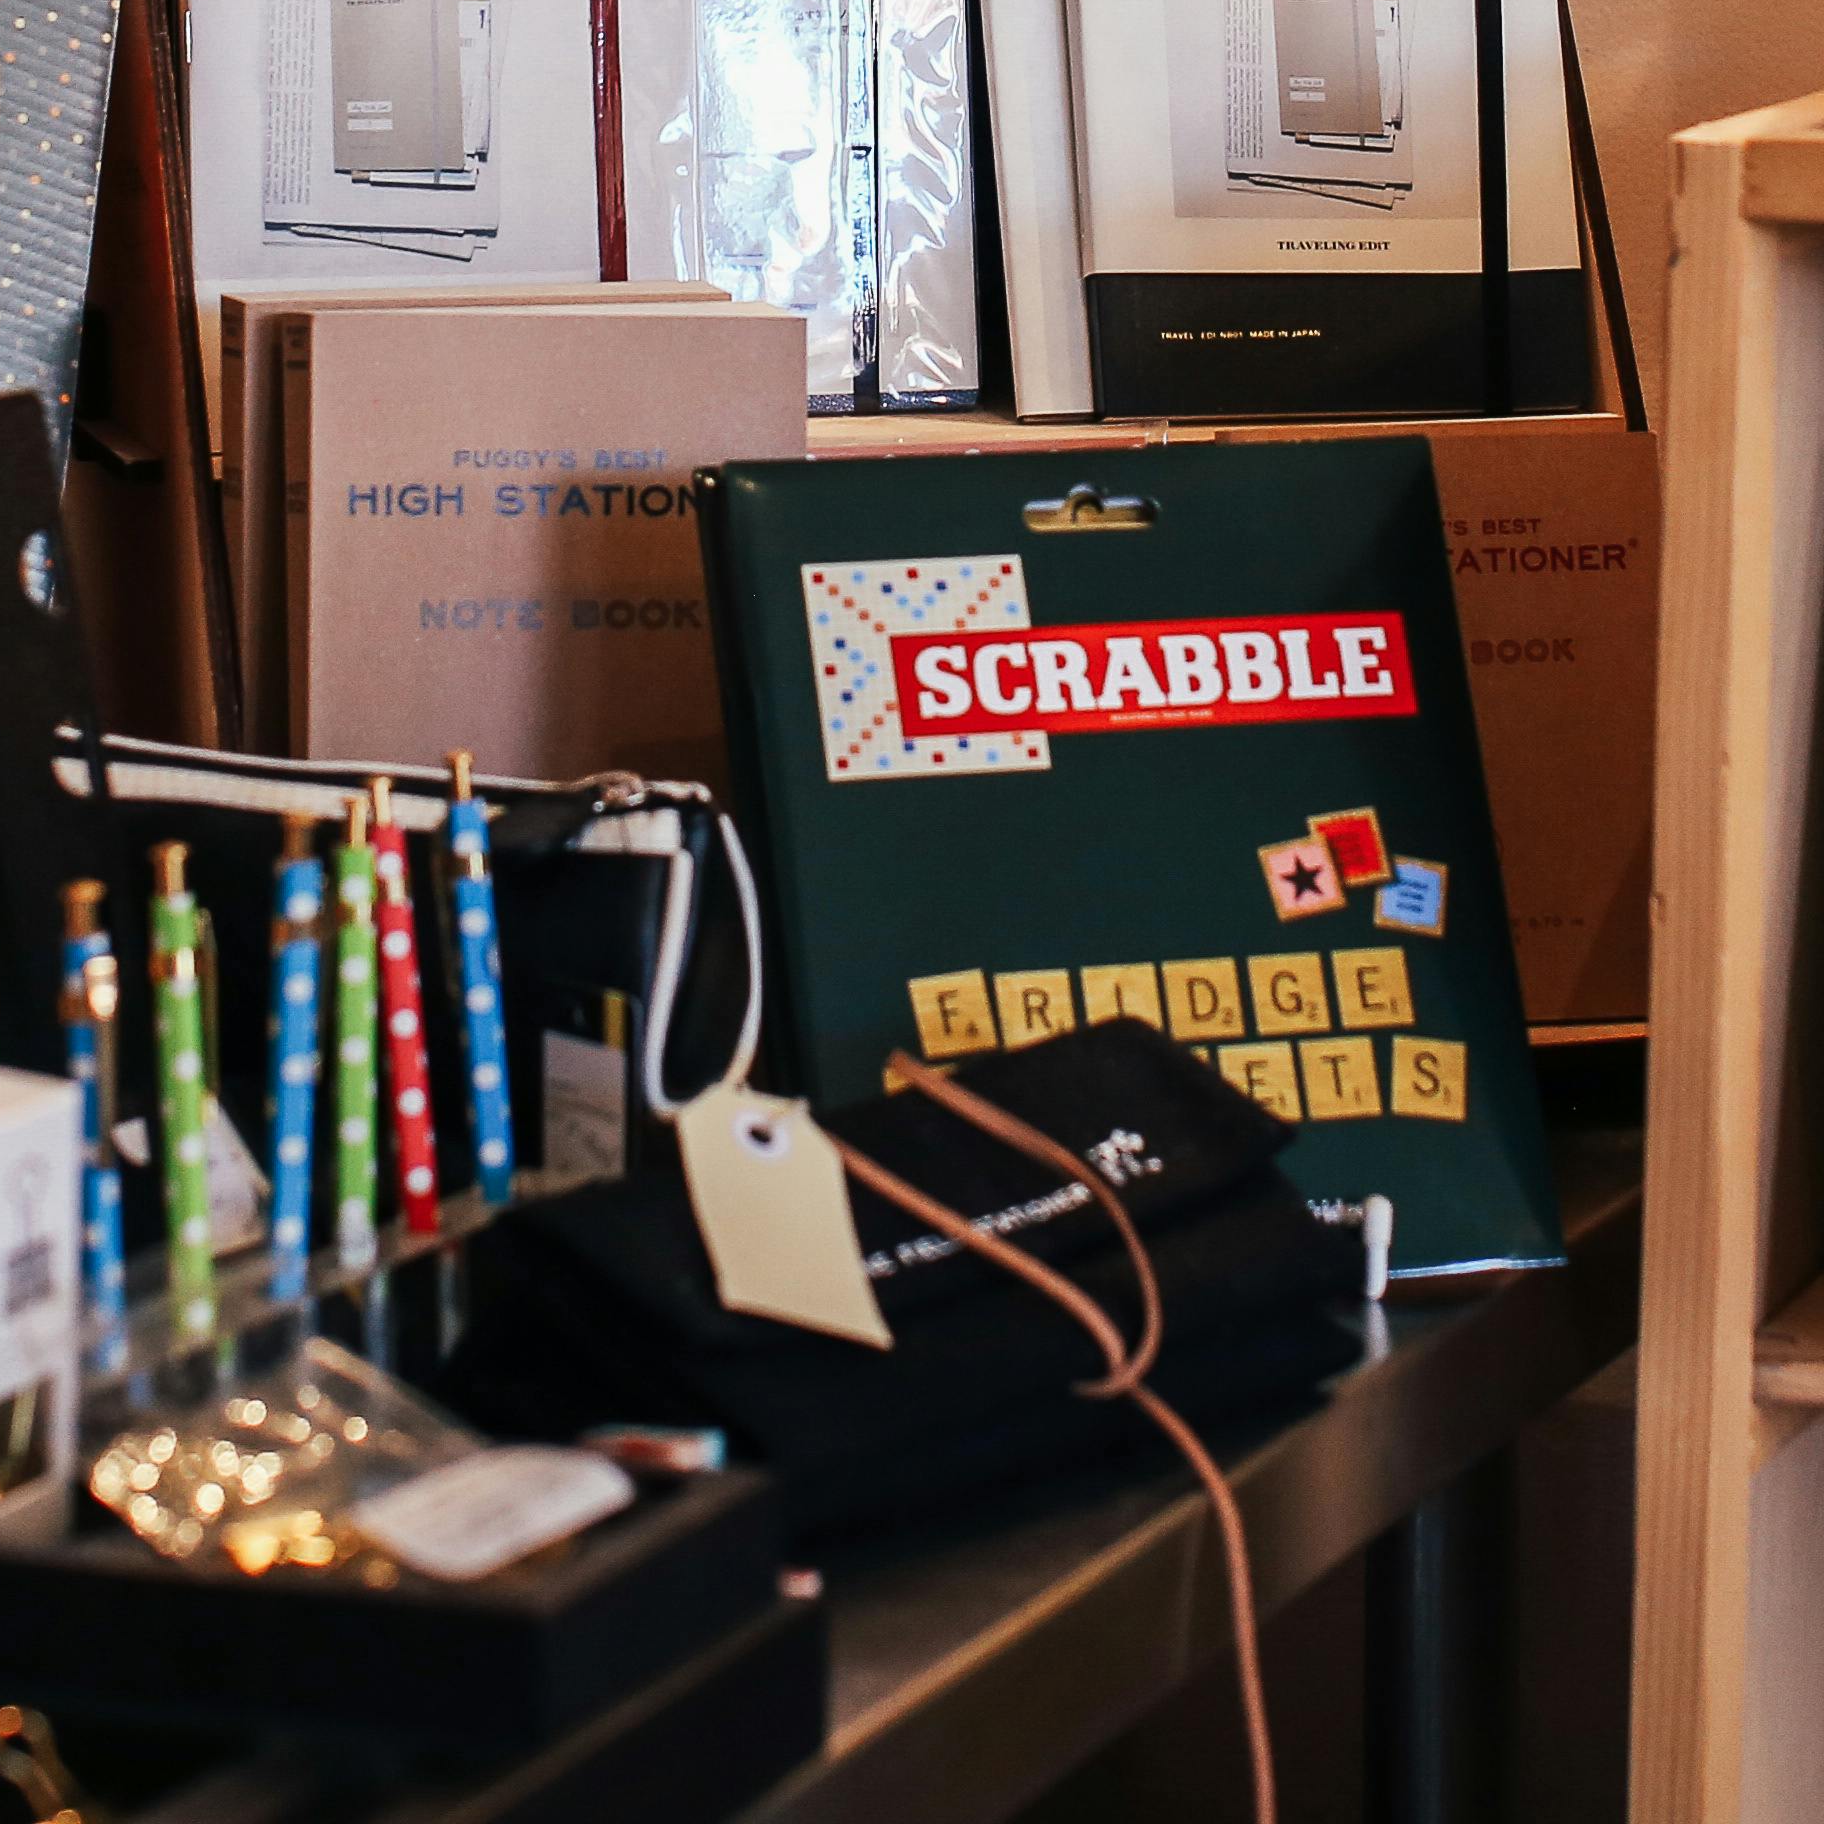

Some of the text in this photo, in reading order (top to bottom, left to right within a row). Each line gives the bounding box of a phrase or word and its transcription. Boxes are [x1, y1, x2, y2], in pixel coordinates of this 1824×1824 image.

[1277, 241, 1355, 251] TRAVELING
[1249, 330, 1274, 338] MADE
[1292, 329, 1321, 337] JAPAN
[593, 448, 670, 469] BEST
[347, 483, 700, 517] HIGH STATION
[1482, 518, 1542, 536] BEST
[420, 598, 703, 631] NOTE BOOK
[1470, 638, 1576, 665] BOOK
[914, 627, 1394, 719] SCRABBLE
[936, 966, 1385, 1037] FRIDGE
